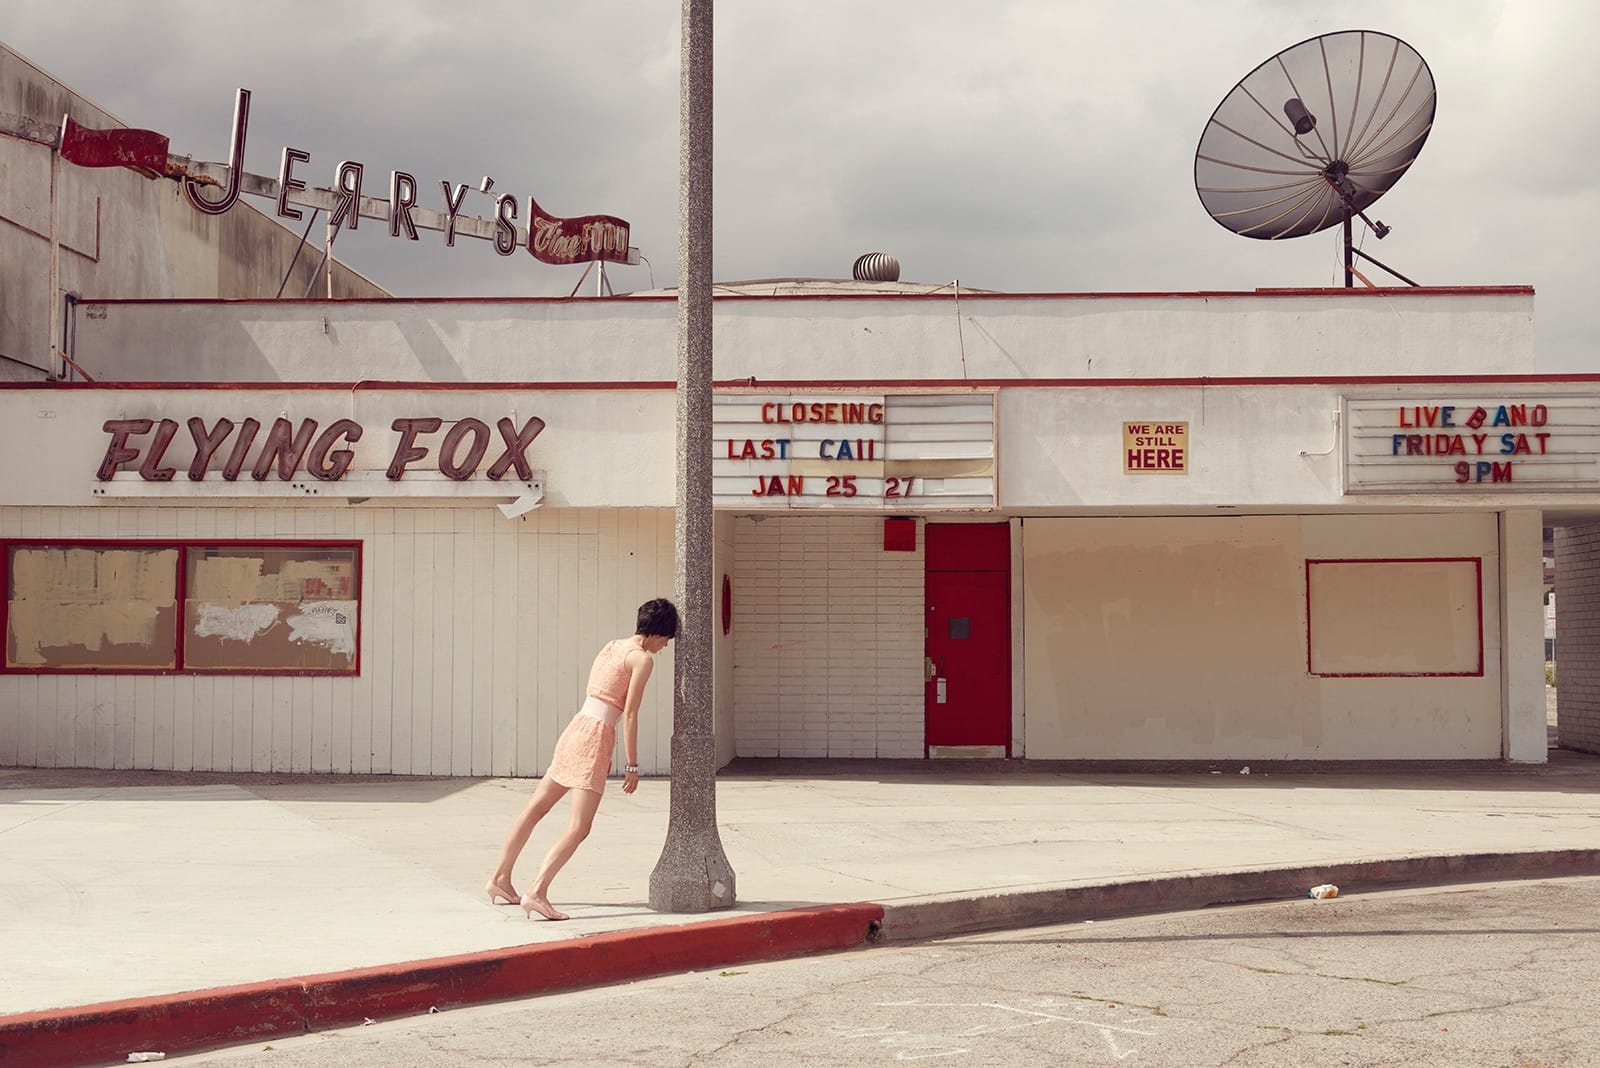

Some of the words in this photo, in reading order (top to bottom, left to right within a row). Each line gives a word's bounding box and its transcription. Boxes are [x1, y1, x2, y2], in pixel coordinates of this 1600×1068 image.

[182, 88, 519, 256] JERRY'S
[581, 221, 628, 256] FOOD
[762, 402, 883, 424] CLOSEING
[1400, 406, 1456, 428] LIVE
[1128, 425, 1150, 434] WE
[1154, 425, 1184, 434] ARE
[96, 417, 363, 481] FLYING
[386, 417, 545, 481] FOX
[728, 439, 791, 460] LAST
[1136, 437, 1176, 446] STILL
[1392, 433, 1488, 456] FRIDAY
[1500, 433, 1551, 456] SAT
[1128, 449, 1184, 468] HERE
[752, 475, 803, 497] JAN
[826, 475, 857, 497] 25
[885, 476, 915, 498] 27
